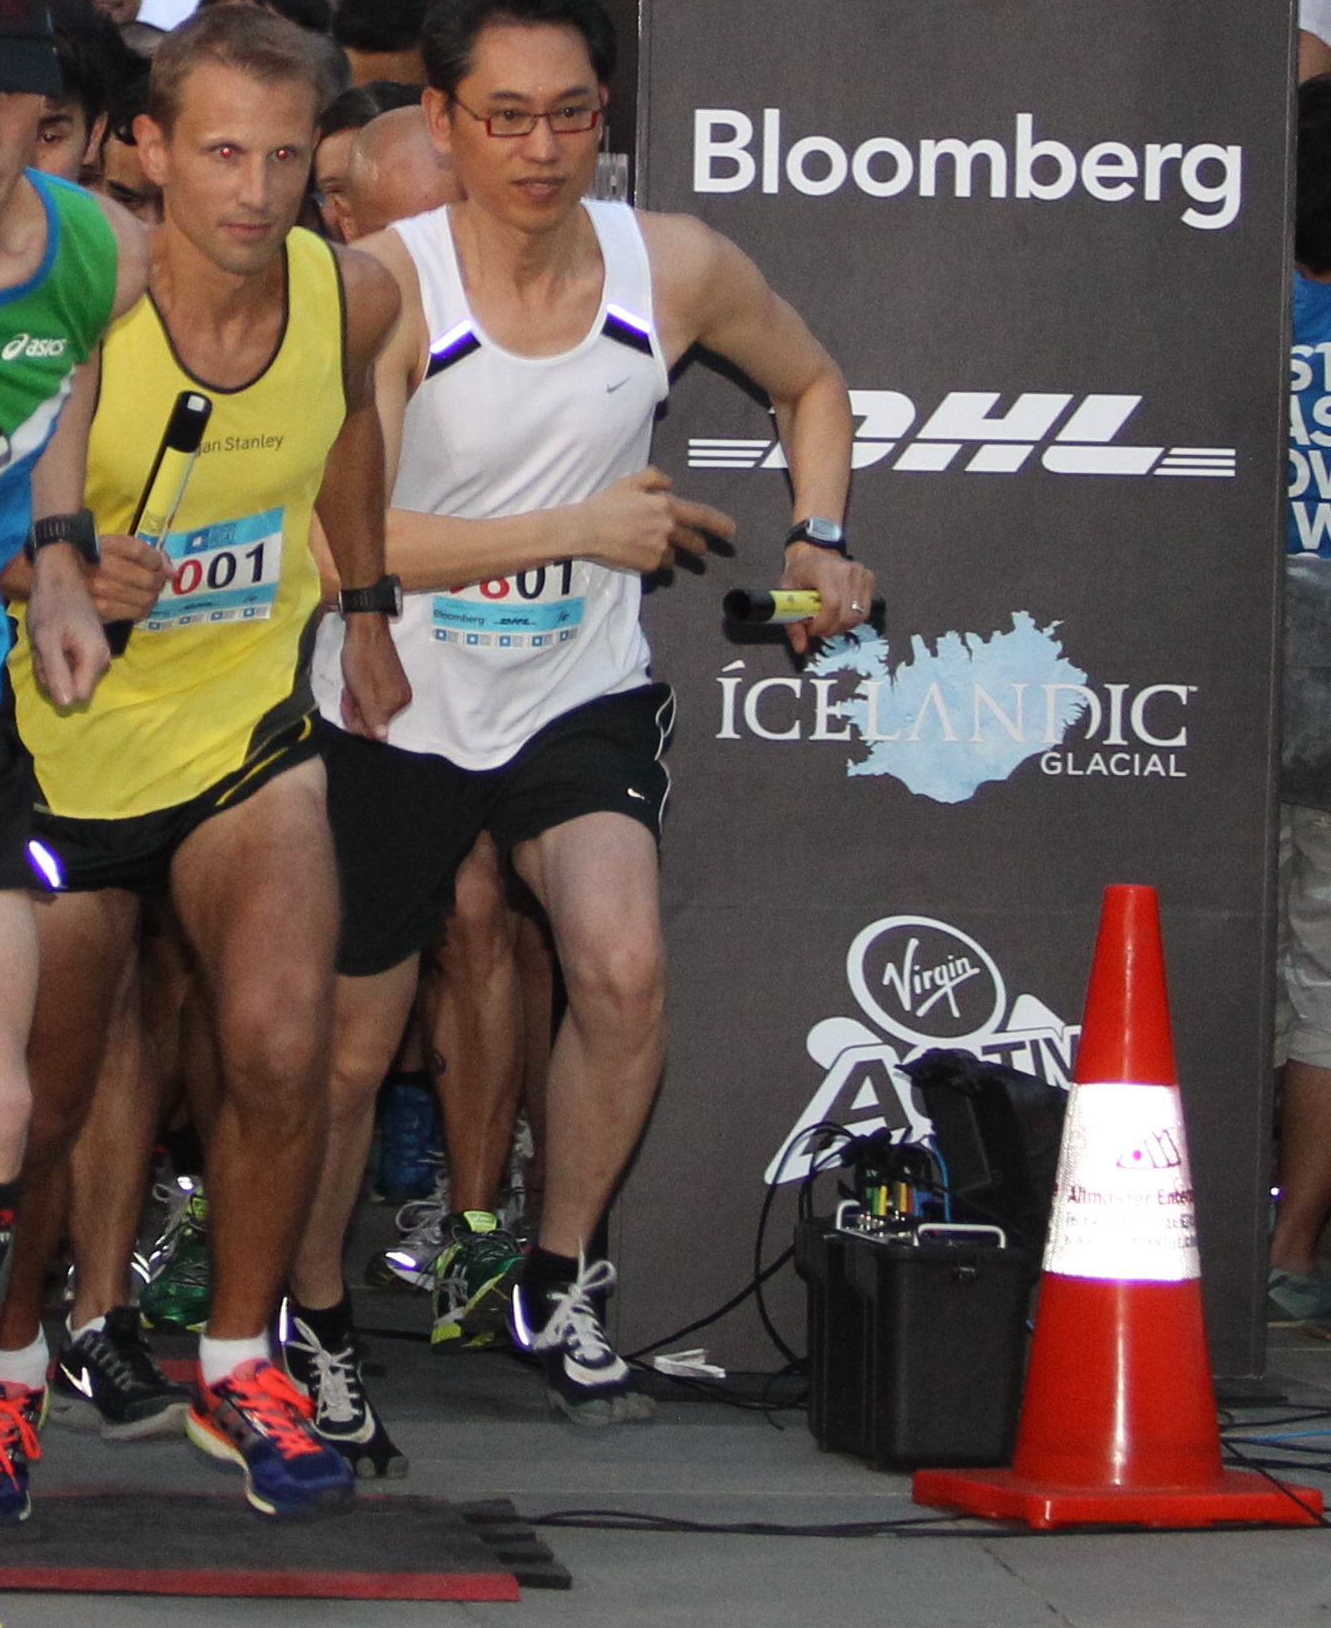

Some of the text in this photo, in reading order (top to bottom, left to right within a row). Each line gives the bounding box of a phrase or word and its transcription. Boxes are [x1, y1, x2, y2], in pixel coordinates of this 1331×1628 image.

[693, 108, 1242, 230] Bloomberg
[224, 434, 284, 453] Stanley
[171, 541, 266, 596] 001
[433, 608, 486, 627] Bloomberg
[1041, 751, 1188, 778] GLACIAL
[882, 937, 981, 1019] Virgin
